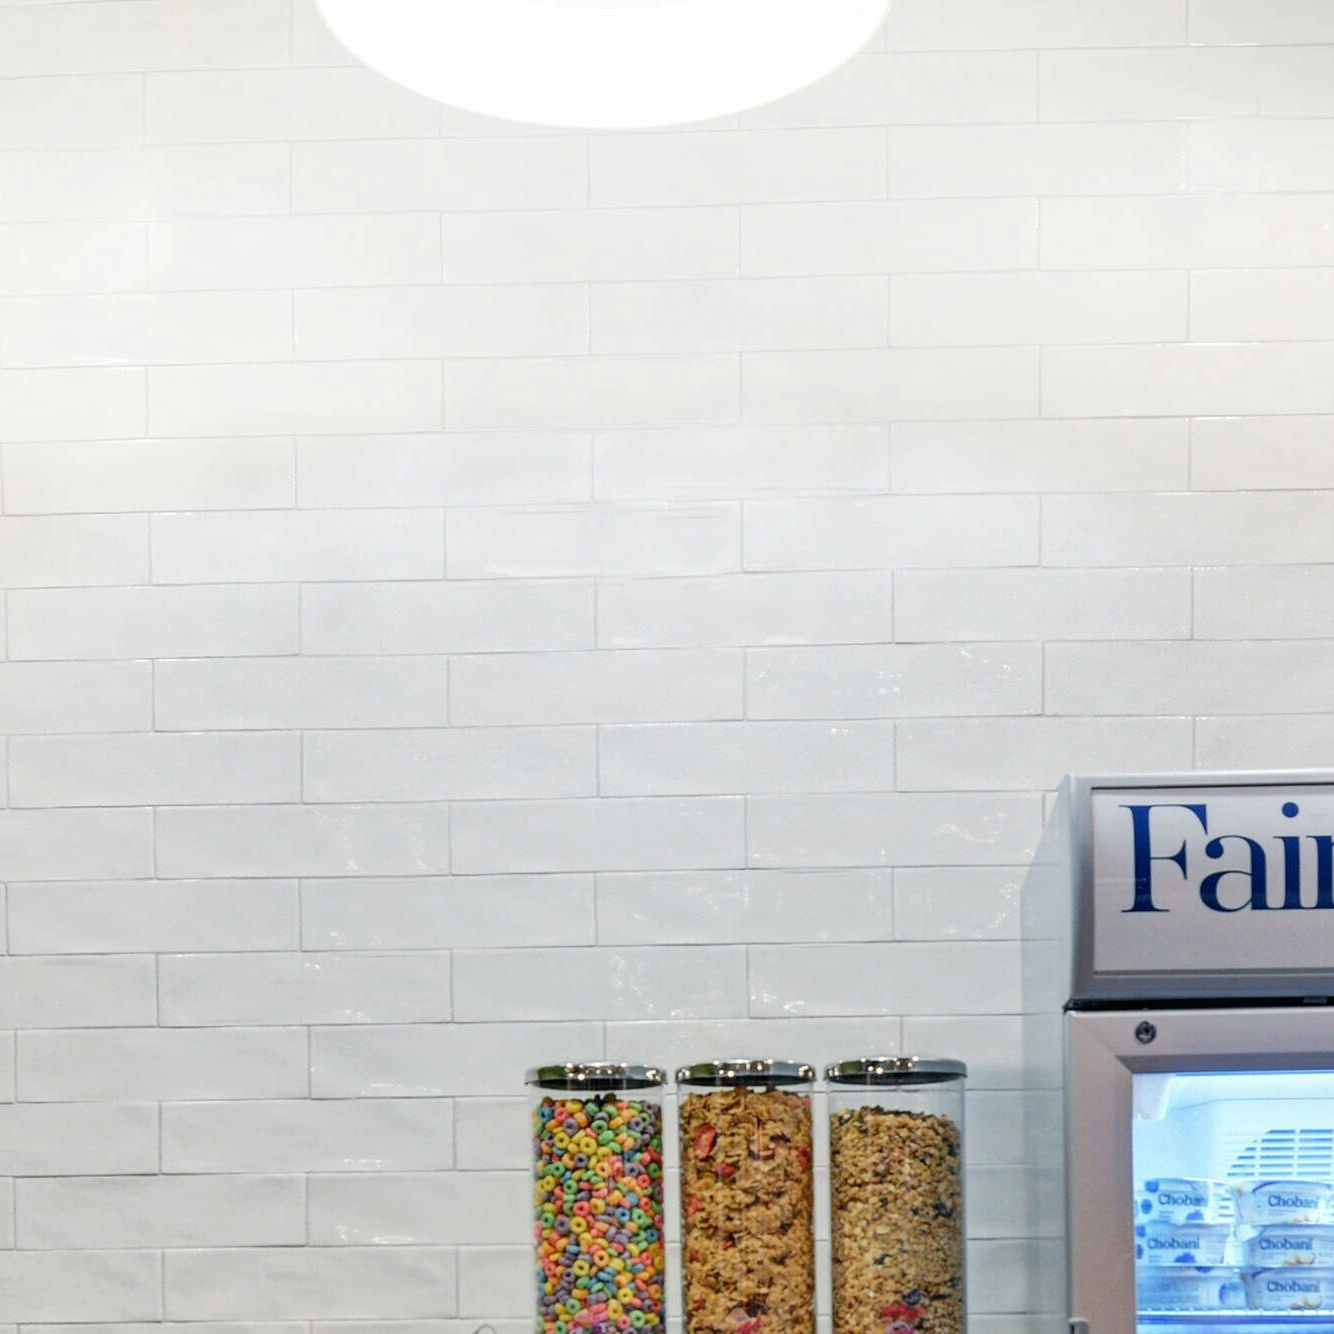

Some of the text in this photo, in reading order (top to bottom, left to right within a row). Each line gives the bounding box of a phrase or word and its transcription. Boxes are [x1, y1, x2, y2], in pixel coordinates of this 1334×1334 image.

[1147, 1237, 1200, 1250] Chobani
[1259, 1237, 1313, 1250] Chobani
[1267, 1280, 1321, 1293] Chobani
